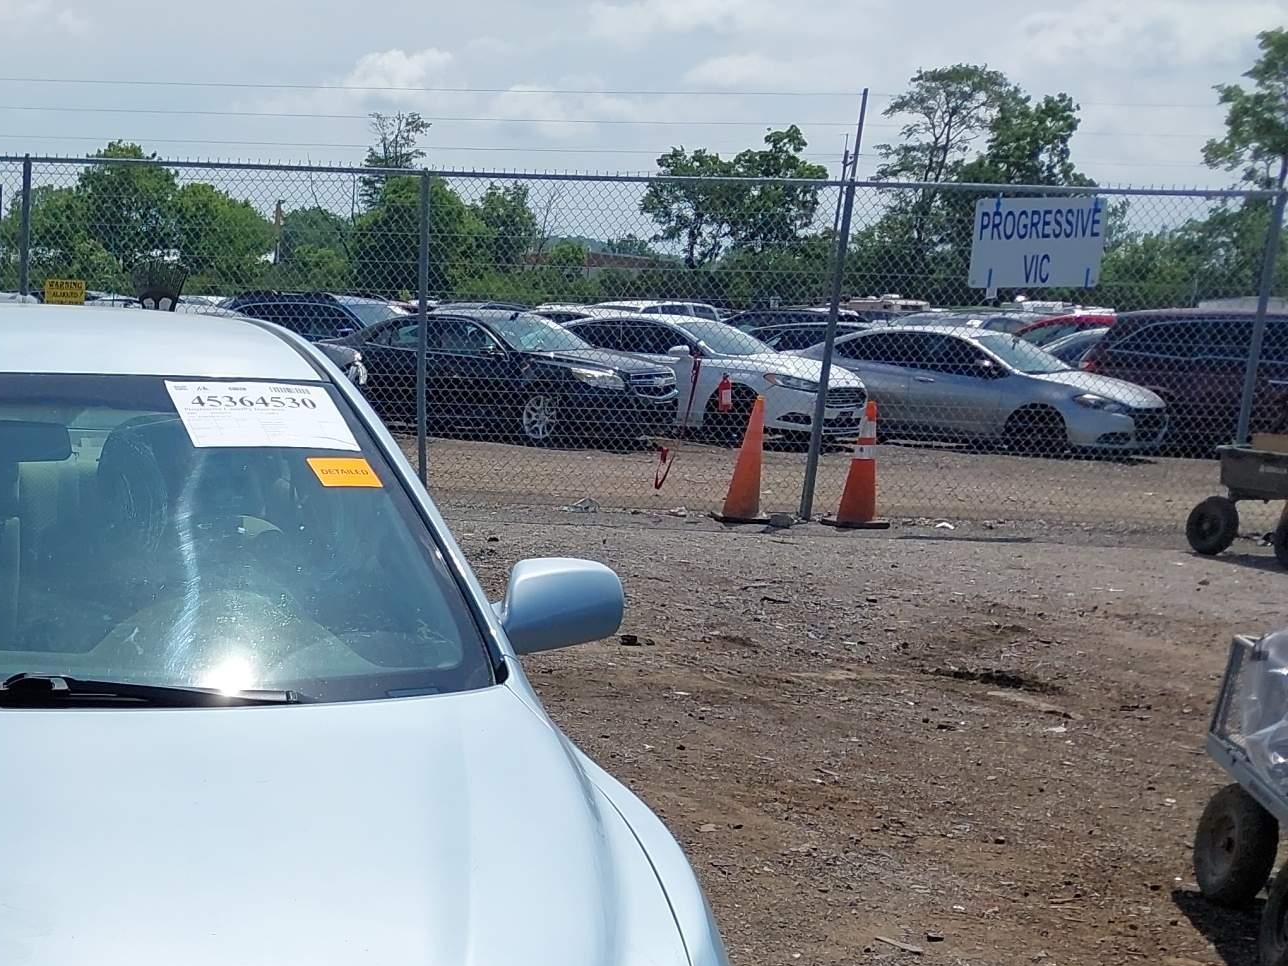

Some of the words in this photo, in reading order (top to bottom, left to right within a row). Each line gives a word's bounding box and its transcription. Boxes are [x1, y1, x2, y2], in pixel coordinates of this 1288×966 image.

[979, 208, 1101, 240] PROGRESSIVE
[1023, 254, 1050, 284] VIC
[191, 395, 317, 409] 45364530
[320, 468, 369, 476] DETAILED
